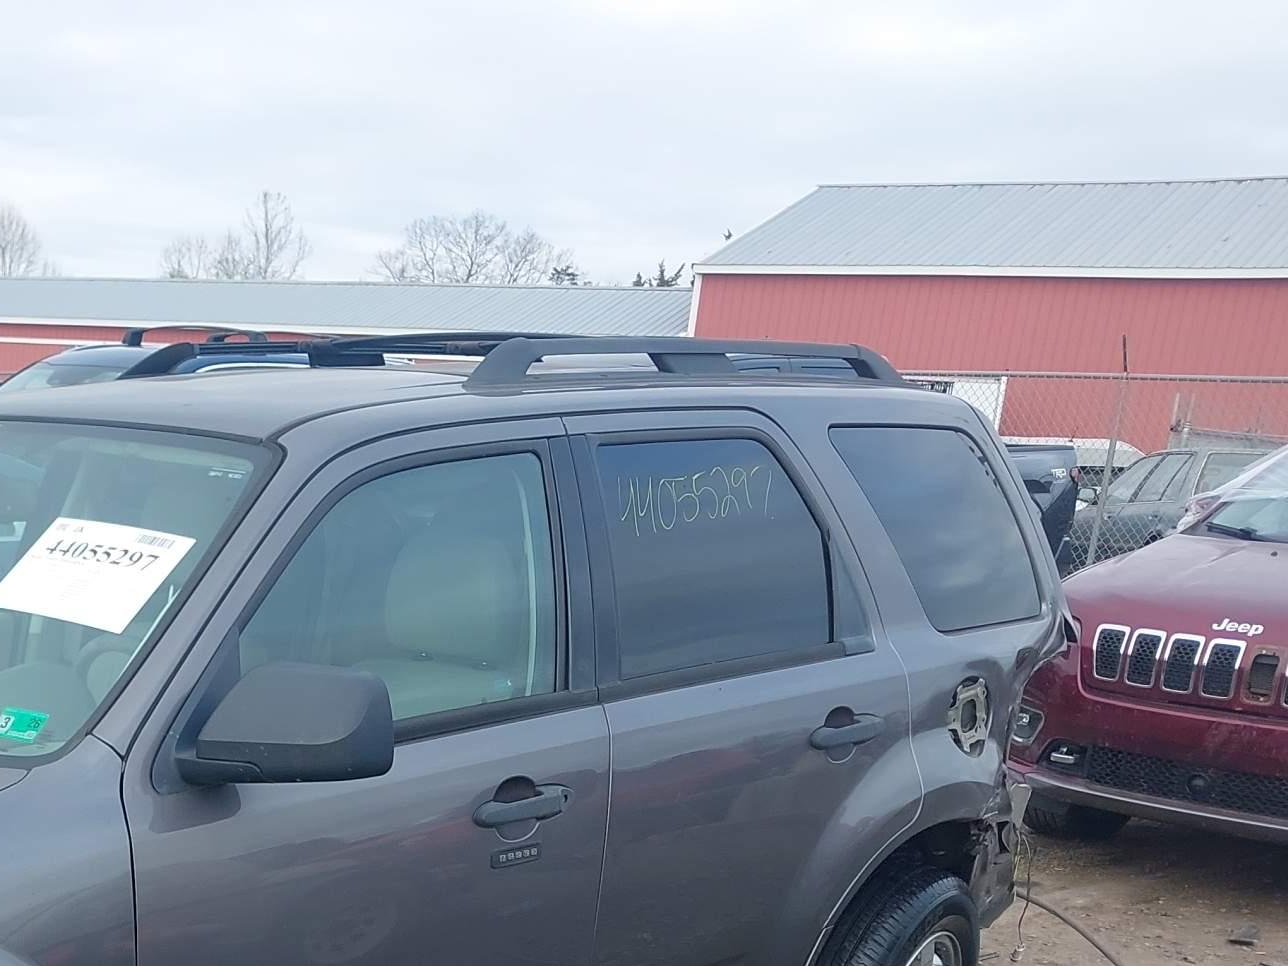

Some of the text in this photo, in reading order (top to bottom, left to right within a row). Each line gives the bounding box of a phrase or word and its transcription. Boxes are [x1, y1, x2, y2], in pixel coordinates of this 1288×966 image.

[45, 539, 161, 572] 44055297
[1211, 618, 1265, 637] Jeep
[0, 716, 42, 729] 3 26
